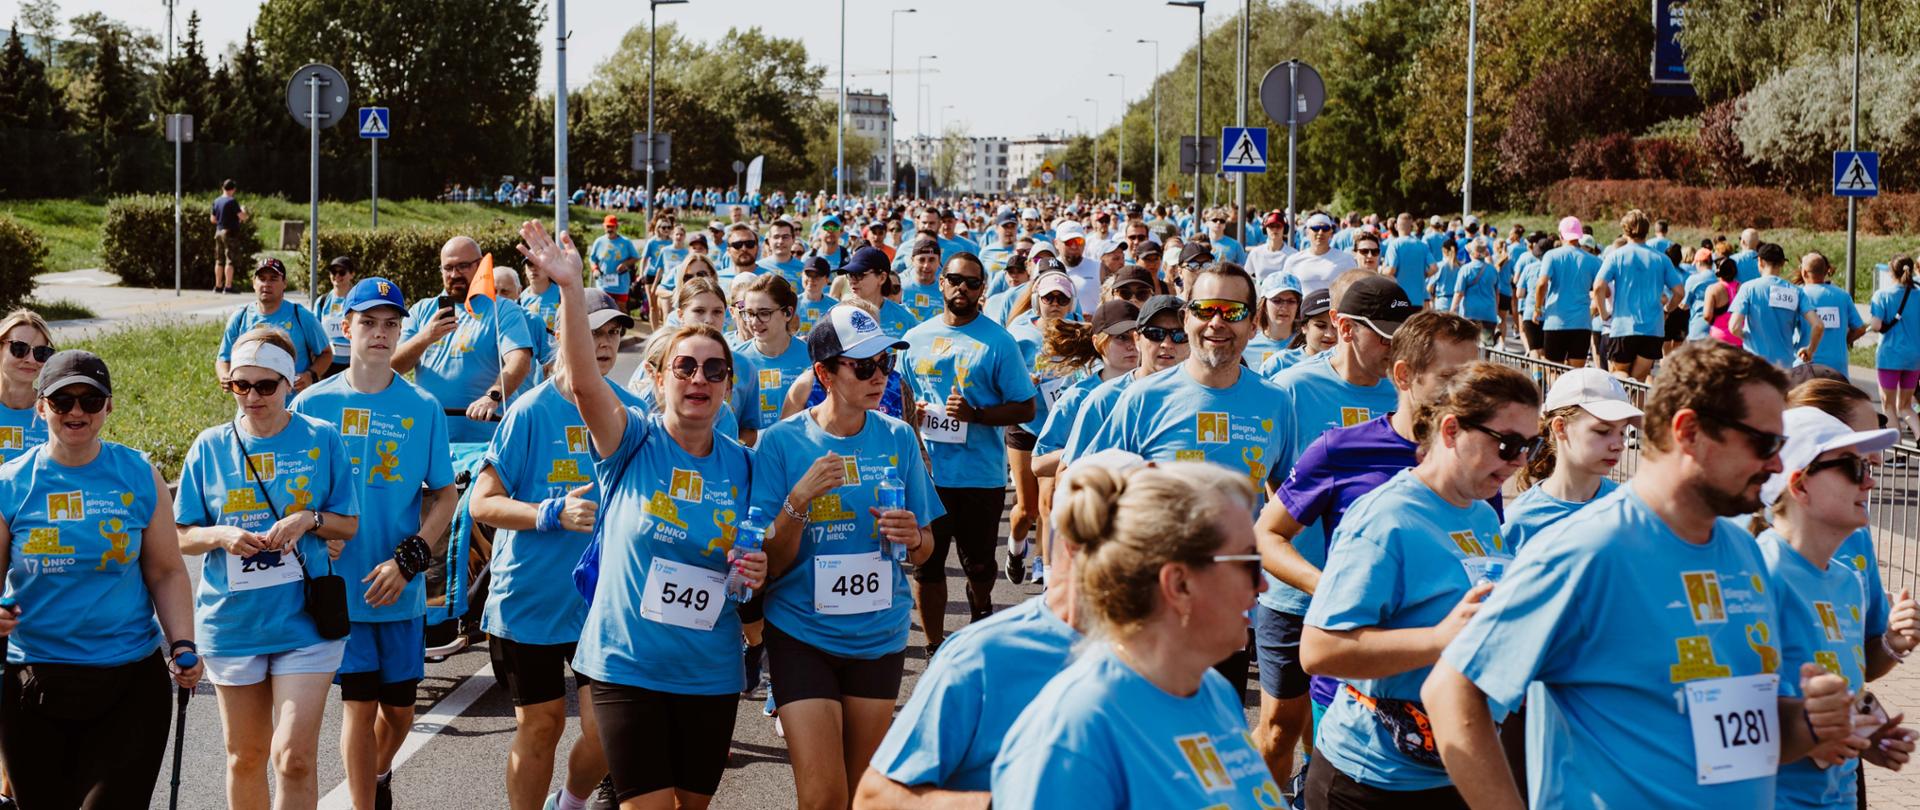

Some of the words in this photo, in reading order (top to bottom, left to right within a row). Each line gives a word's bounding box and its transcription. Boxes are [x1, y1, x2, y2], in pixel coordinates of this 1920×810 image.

[1776, 293, 1794, 303] 336
[331, 323, 343, 331] 71
[926, 414, 960, 432] 1649
[811, 525, 825, 544] 17
[23, 557, 39, 575] 17
[831, 572, 880, 597] 486
[660, 581, 711, 612] 549
[1714, 708, 1771, 749] 1281
